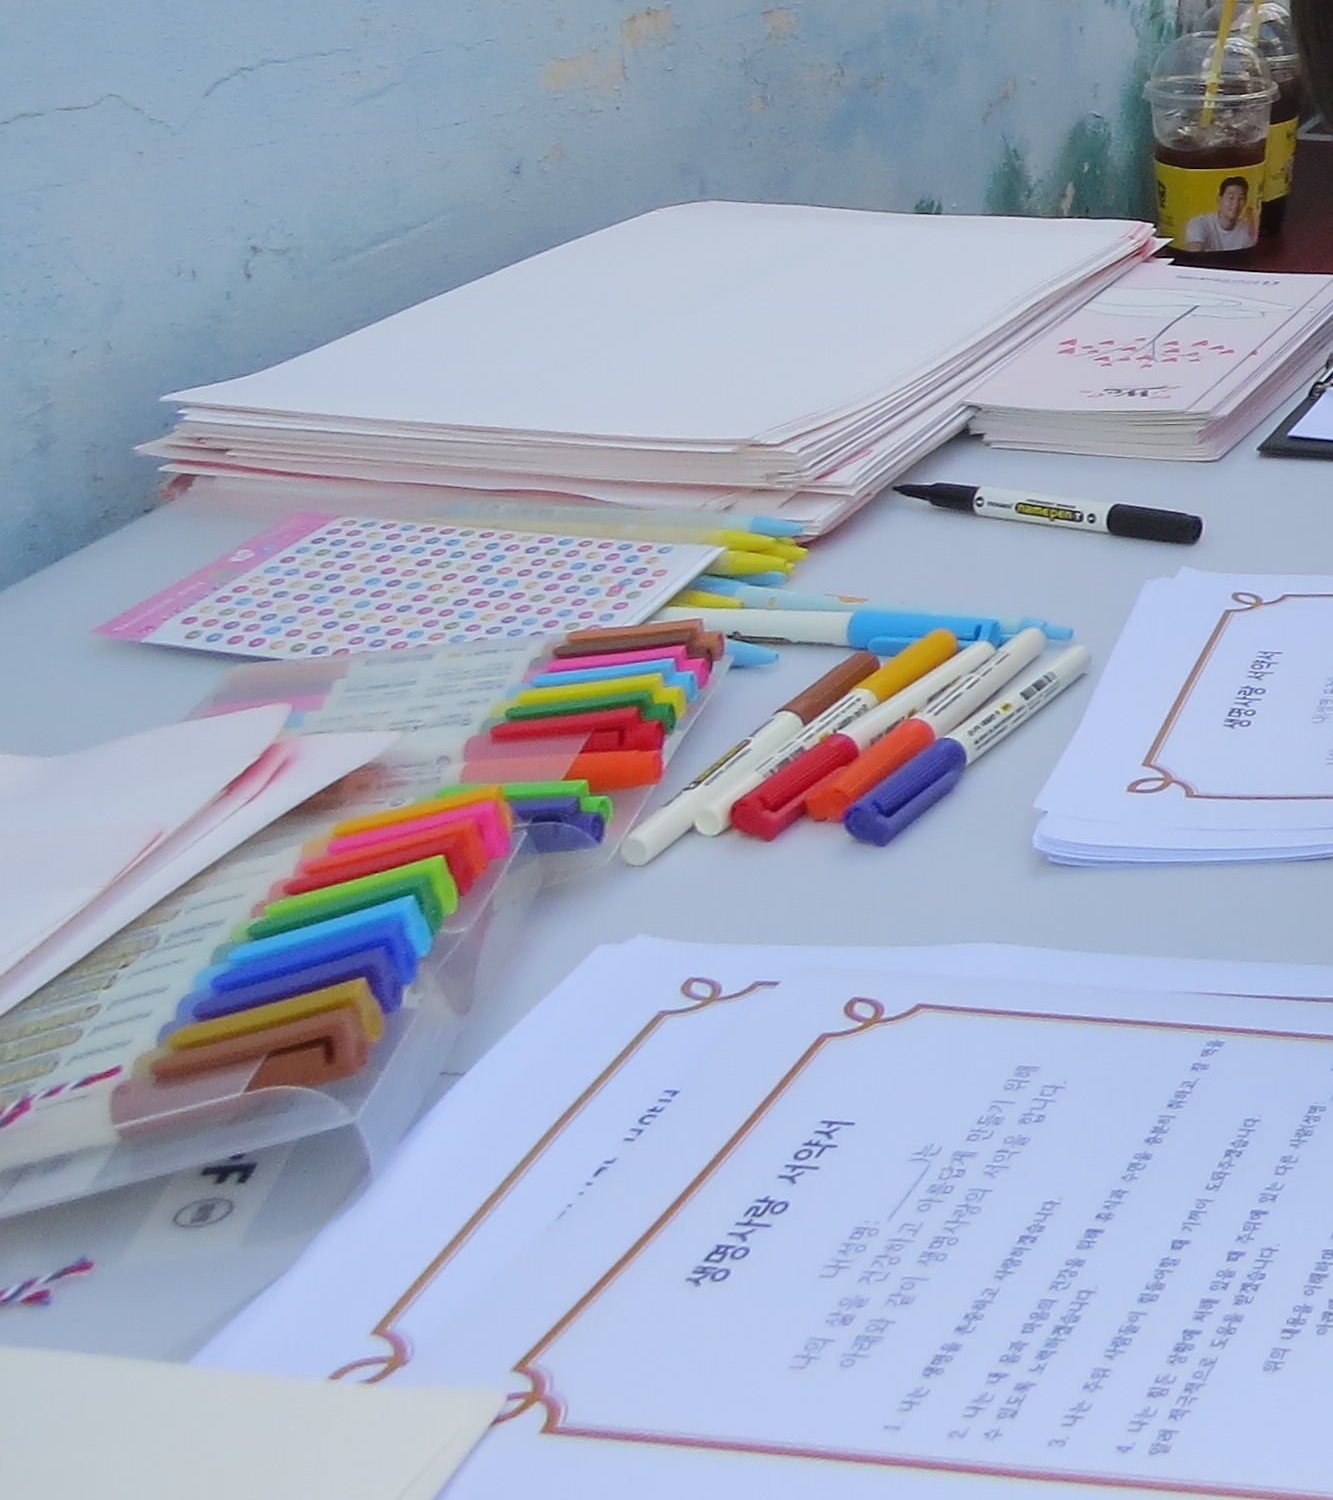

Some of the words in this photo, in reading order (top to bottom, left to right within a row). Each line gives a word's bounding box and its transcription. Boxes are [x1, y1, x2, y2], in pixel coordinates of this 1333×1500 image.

[1222, 684, 1266, 729] 생명사랑
[1245, 650, 1283, 681] 서약서
[1273, 1154, 1299, 1176] 다른
[684, 1195, 790, 1287] 생명사랑
[776, 1119, 856, 1185] 서약서
[1257, 1181, 1284, 1203] 있는
[788, 1337, 834, 1370] 나의
[824, 1295, 869, 1326] 삶을
[857, 1222, 924, 1284] 건강하고
[916, 1150, 978, 1212] 아름답게
[965, 1099, 1015, 1142] 만들기
[1002, 1065, 1040, 1091] 위해
[1234, 1209, 1269, 1244] 주위에
[839, 1318, 896, 1368] 아래와
[884, 1276, 928, 1306] 같이
[916, 1187, 993, 1266] 생명사랑의
[982, 1134, 1030, 1178] 서약을
[947, 1428, 968, 1439] 2.
[961, 1392, 994, 1418] 나는
[985, 1371, 1009, 1384] 내
[1020, 1298, 1058, 1334] 마음의
[1047, 1257, 1085, 1291] 건강을
[1075, 1227, 1104, 1250] 위해
[1094, 1188, 1129, 1222] 휴식과
[1120, 1151, 1153, 1182] 수면을
[1143, 1114, 1176, 1145] 충분히
[1189, 1062, 1210, 1072] 잘
[1225, 1250, 1246, 1262] 때
[1208, 1268, 1236, 1291] 있을
[1046, 1436, 1069, 1447] 3.
[1060, 1400, 1092, 1427] 나는
[1081, 1367, 1111, 1393] 주위
[1103, 1310, 1147, 1360] 사람들이
[1136, 1256, 1180, 1304] 힘들어할
[1169, 1238, 1191, 1251] 때
[1180, 1198, 1214, 1232] 기꺼이
[1191, 1298, 1220, 1322] 처해
[897, 1386, 930, 1412] 나는
[921, 1342, 962, 1379] 생명을
[953, 1287, 1000, 1335] 존중하고
[1166, 1328, 1202, 1365] 상황에
[1261, 1347, 1291, 1372] 위의
[1280, 1303, 1313, 1340] 내용을
[1146, 1374, 1177, 1398] 힘든
[1147, 1428, 1179, 1456] 알려
[1167, 1356, 1218, 1421] 적극적으로
[1209, 1313, 1244, 1349] 도움을
[982, 1428, 1003, 1441] 수
[995, 1381, 1037, 1420] 있도록
[1126, 1406, 1157, 1433] 나는
[1115, 1445, 1133, 1453] 4.
